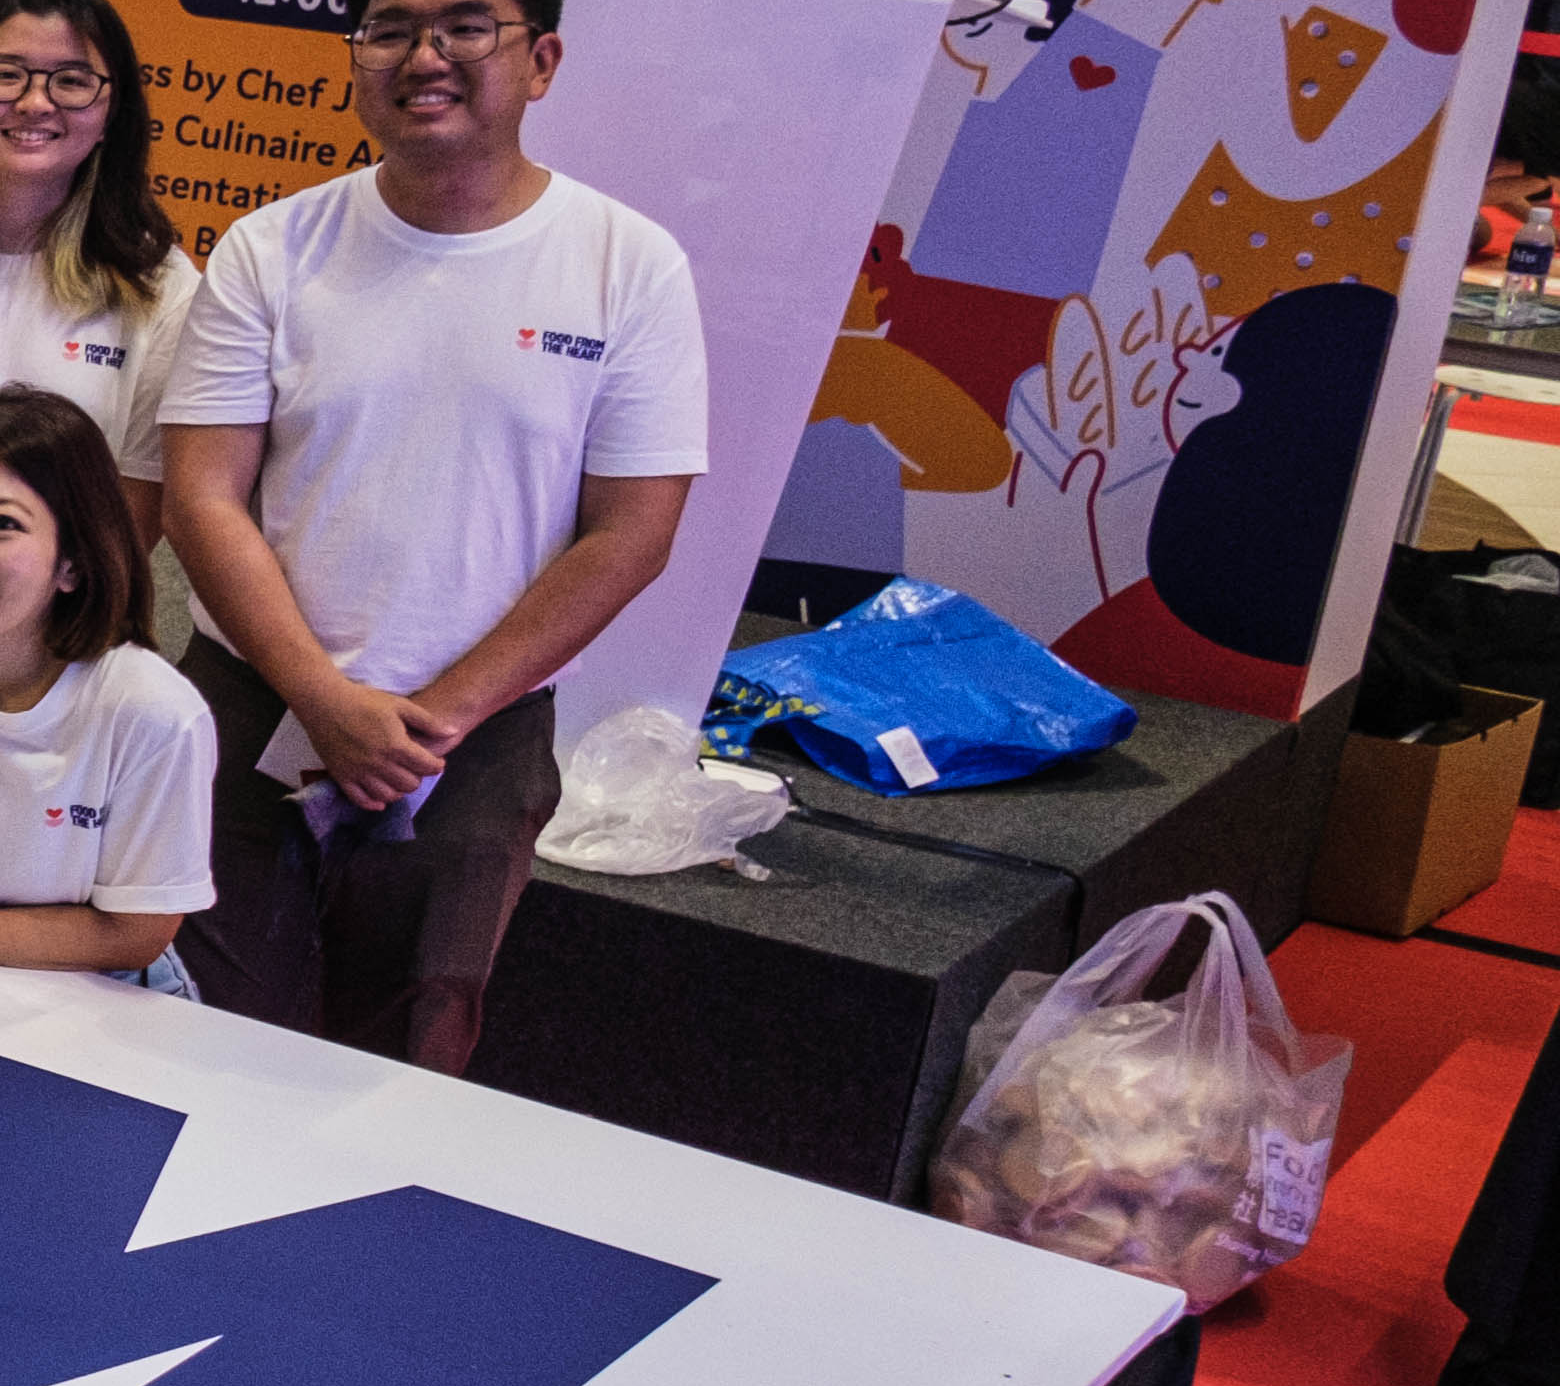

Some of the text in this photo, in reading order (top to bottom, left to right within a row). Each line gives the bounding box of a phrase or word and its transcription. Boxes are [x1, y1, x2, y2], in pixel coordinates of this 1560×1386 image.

[184, 60, 226, 102] by
[237, 68, 329, 110] Chef
[176, 115, 337, 166] Culinaire
[542, 331, 606, 349] FOOD FROM
[542, 342, 602, 362] THE HEART
